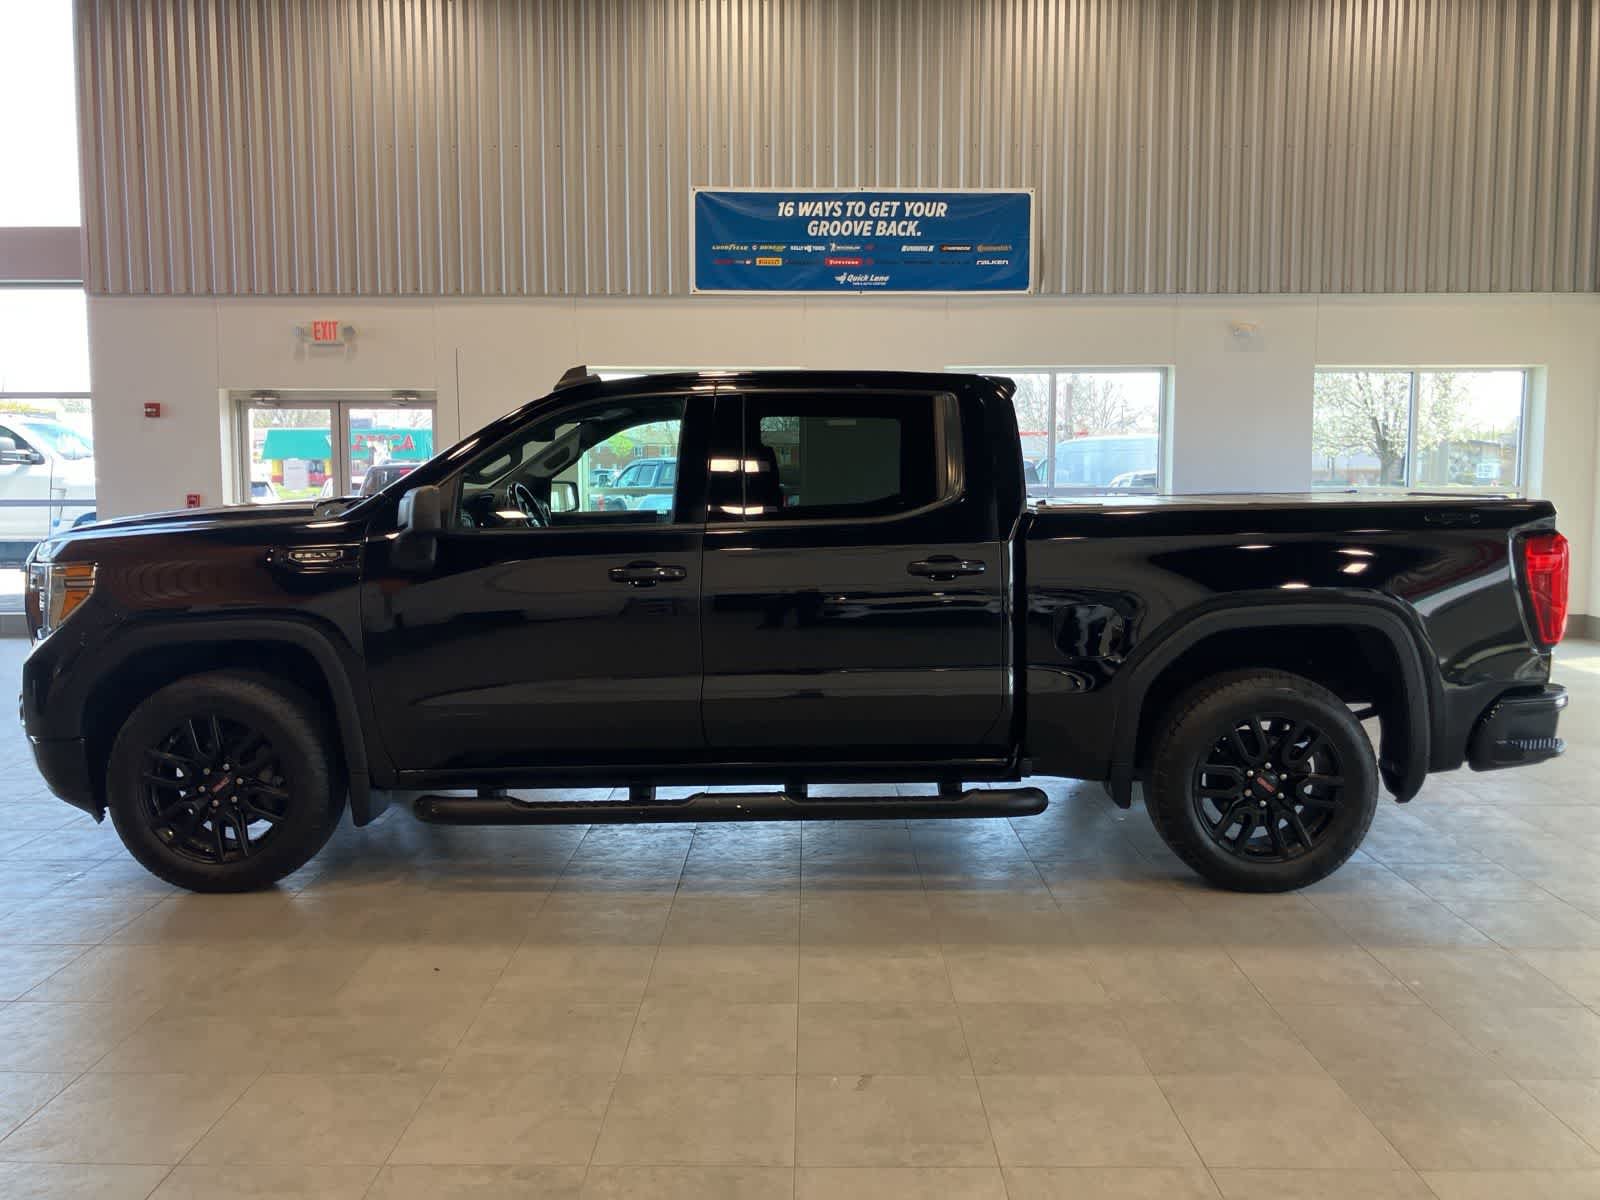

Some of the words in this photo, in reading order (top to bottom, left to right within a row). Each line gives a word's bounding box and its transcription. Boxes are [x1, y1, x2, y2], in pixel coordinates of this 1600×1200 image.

[777, 201, 795, 217] 16
[798, 201, 843, 217] WAYS
[846, 201, 866, 217] TO
[869, 201, 900, 217] GET
[904, 201, 948, 217] YOUR
[807, 220, 873, 237] GROOVE
[875, 220, 922, 237] BACK.
[847, 273, 869, 282] Quick
[870, 273, 890, 282] Lane
[313, 320, 338, 341] EXIT
